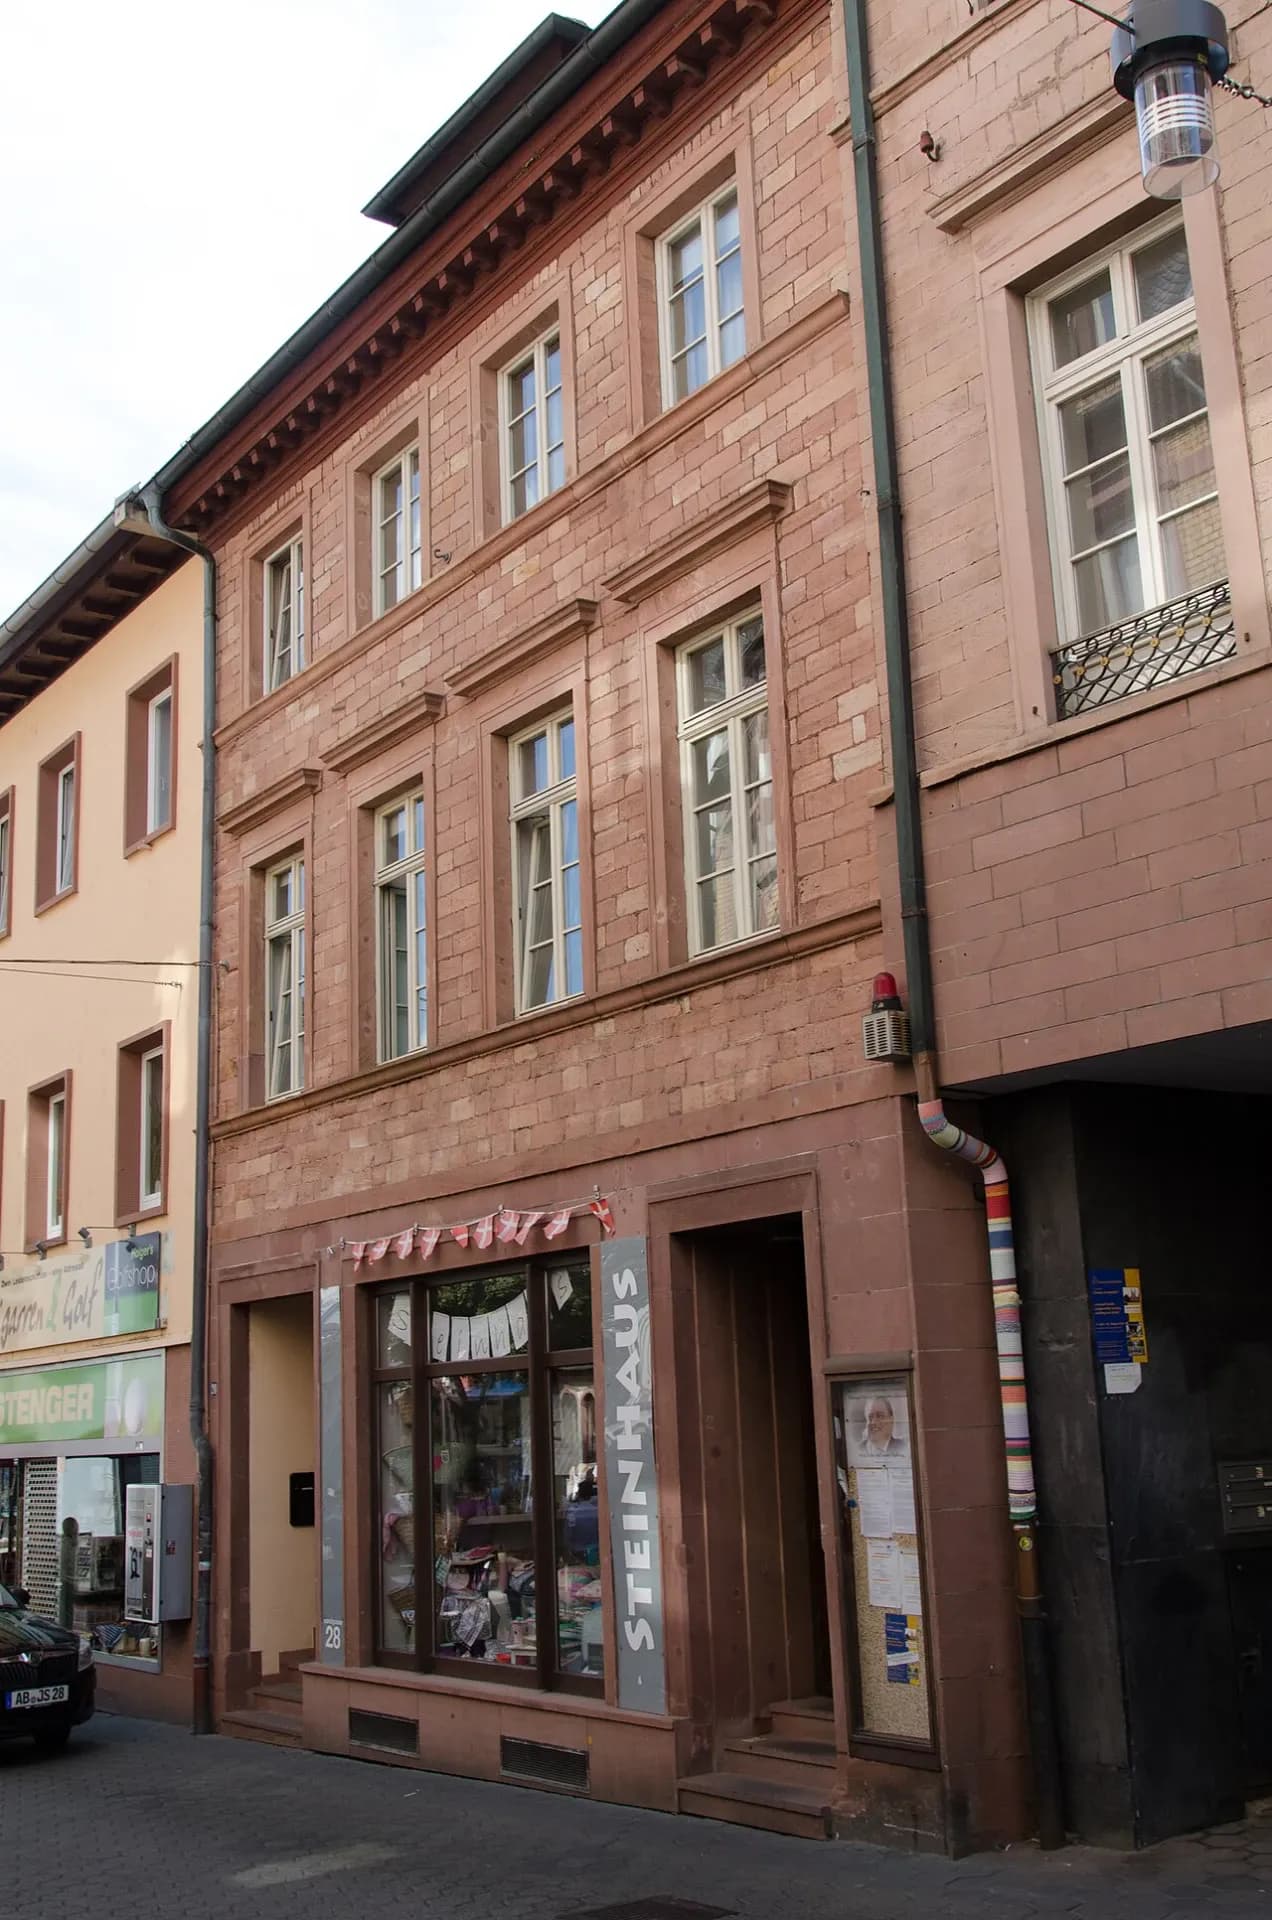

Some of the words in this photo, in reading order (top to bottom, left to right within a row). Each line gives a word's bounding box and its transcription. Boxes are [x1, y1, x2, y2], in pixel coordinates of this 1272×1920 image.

[0, 1299, 43, 1349] garren
[63, 1256, 103, 1331] Golf
[613, 1267, 655, 1653] STEINHAUS
[325, 1625, 341, 1650] 28
[15, 1691, 30, 1705] AB
[52, 1687, 65, 1700] 28
